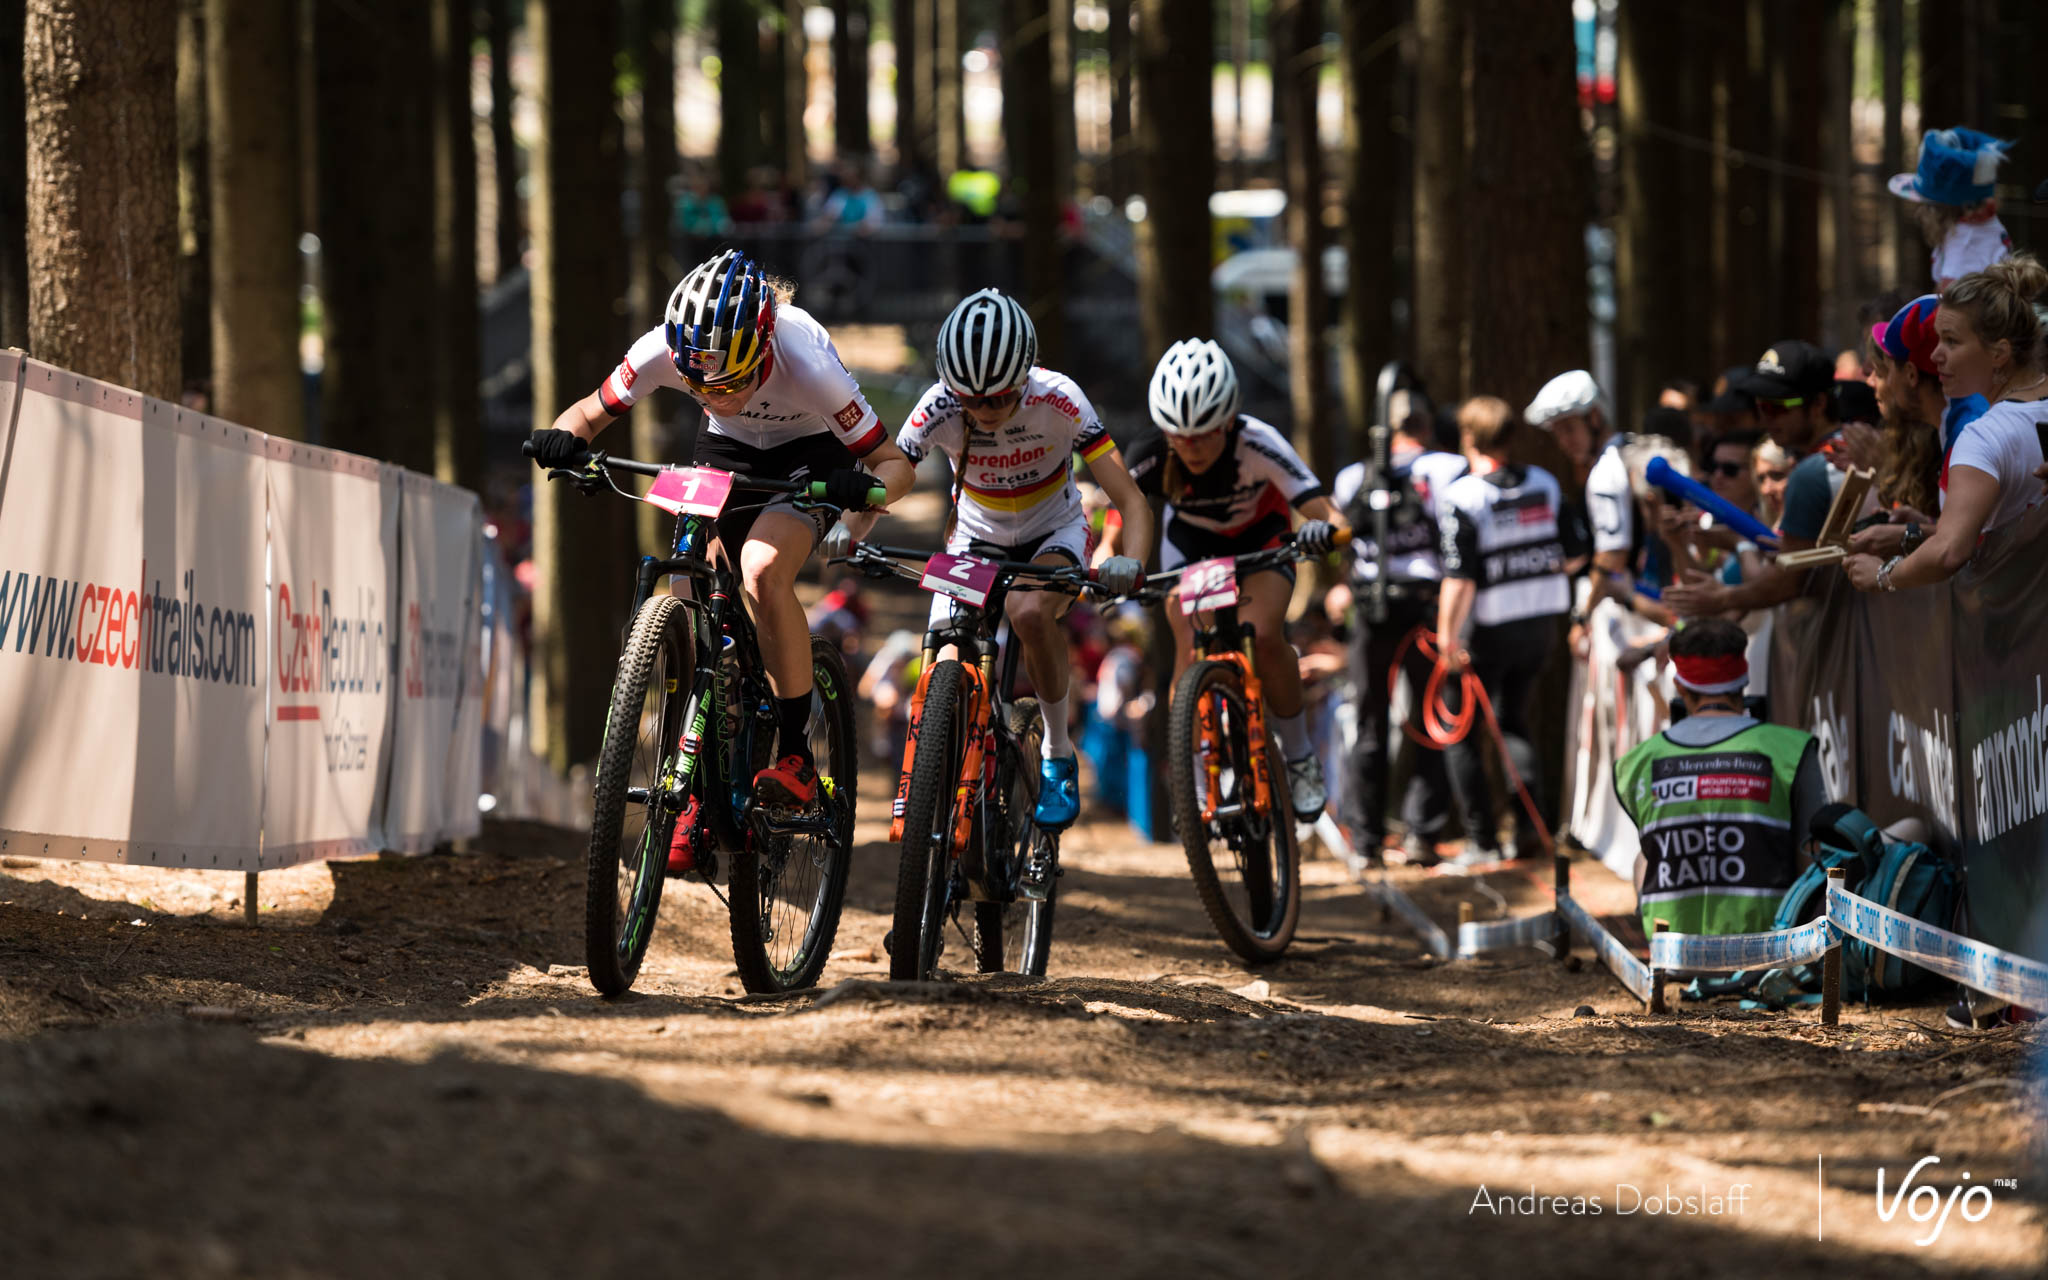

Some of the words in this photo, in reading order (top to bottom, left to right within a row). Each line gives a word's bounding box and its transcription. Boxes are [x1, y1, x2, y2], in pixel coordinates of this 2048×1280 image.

[703, 362, 718, 371] Bull
[844, 414, 861, 428] TAL
[980, 469, 1039, 484] Circus
[682, 478, 701, 500] 1
[949, 559, 975, 580] 2
[1678, 757, 1763, 772] Mercedes-Benz
[1658, 780, 1693, 800] UCI
[1700, 777, 1747, 787] MOUNTAIN
[1748, 779, 1767, 789] BIKE
[1733, 787, 1750, 796] CUP
[1654, 826, 1745, 859] VIDEO
